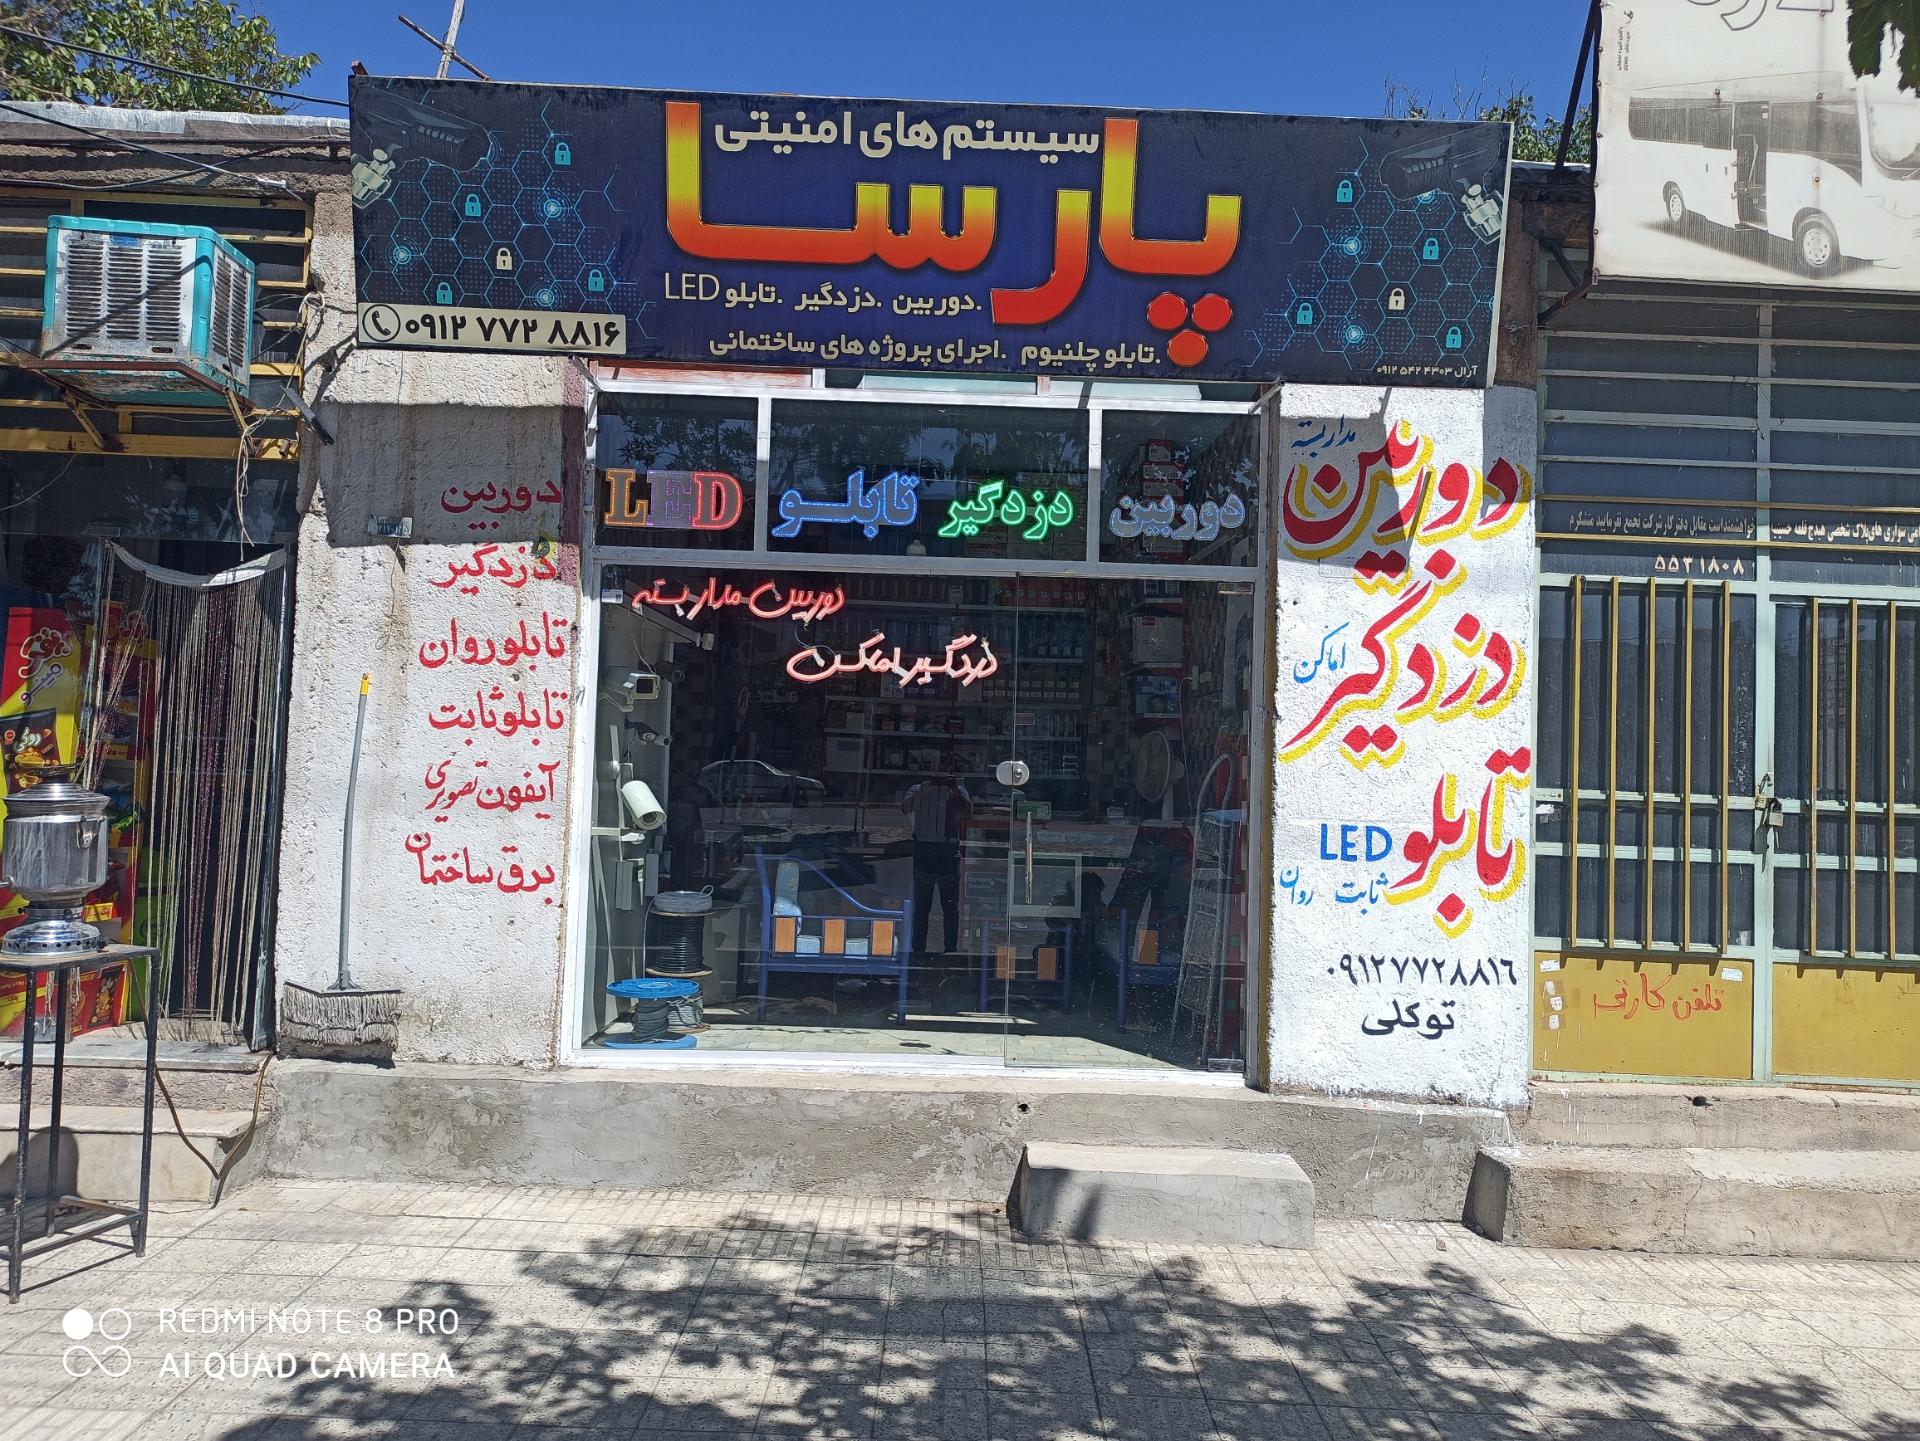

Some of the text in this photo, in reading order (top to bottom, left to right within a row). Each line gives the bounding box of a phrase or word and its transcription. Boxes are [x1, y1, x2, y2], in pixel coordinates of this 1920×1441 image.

[715, 109, 1100, 164] سیستم های امنیتی
[665, 101, 1242, 368] پارسا
[664, 272, 720, 300] LED
[709, 330, 815, 355] ساختمانی
[820, 334, 864, 360] های
[868, 334, 932, 367] پروژه
[1021, 341, 1100, 372] چلنیوم
[439, 476, 562, 531] دوربین
[604, 467, 920, 540] تابلو LED
[937, 479, 1075, 542] دزدگیر
[1109, 491, 1246, 542] دوربین
[1282, 418, 1525, 585] دوربین
[430, 540, 560, 597] دزدگیر
[1280, 579, 1520, 755] دزدگیر
[1320, 822, 1393, 862] LED
[1388, 746, 1532, 930] تابلو
[497, 844, 557, 906] برق
[1361, 999, 1456, 1040] توکلی
